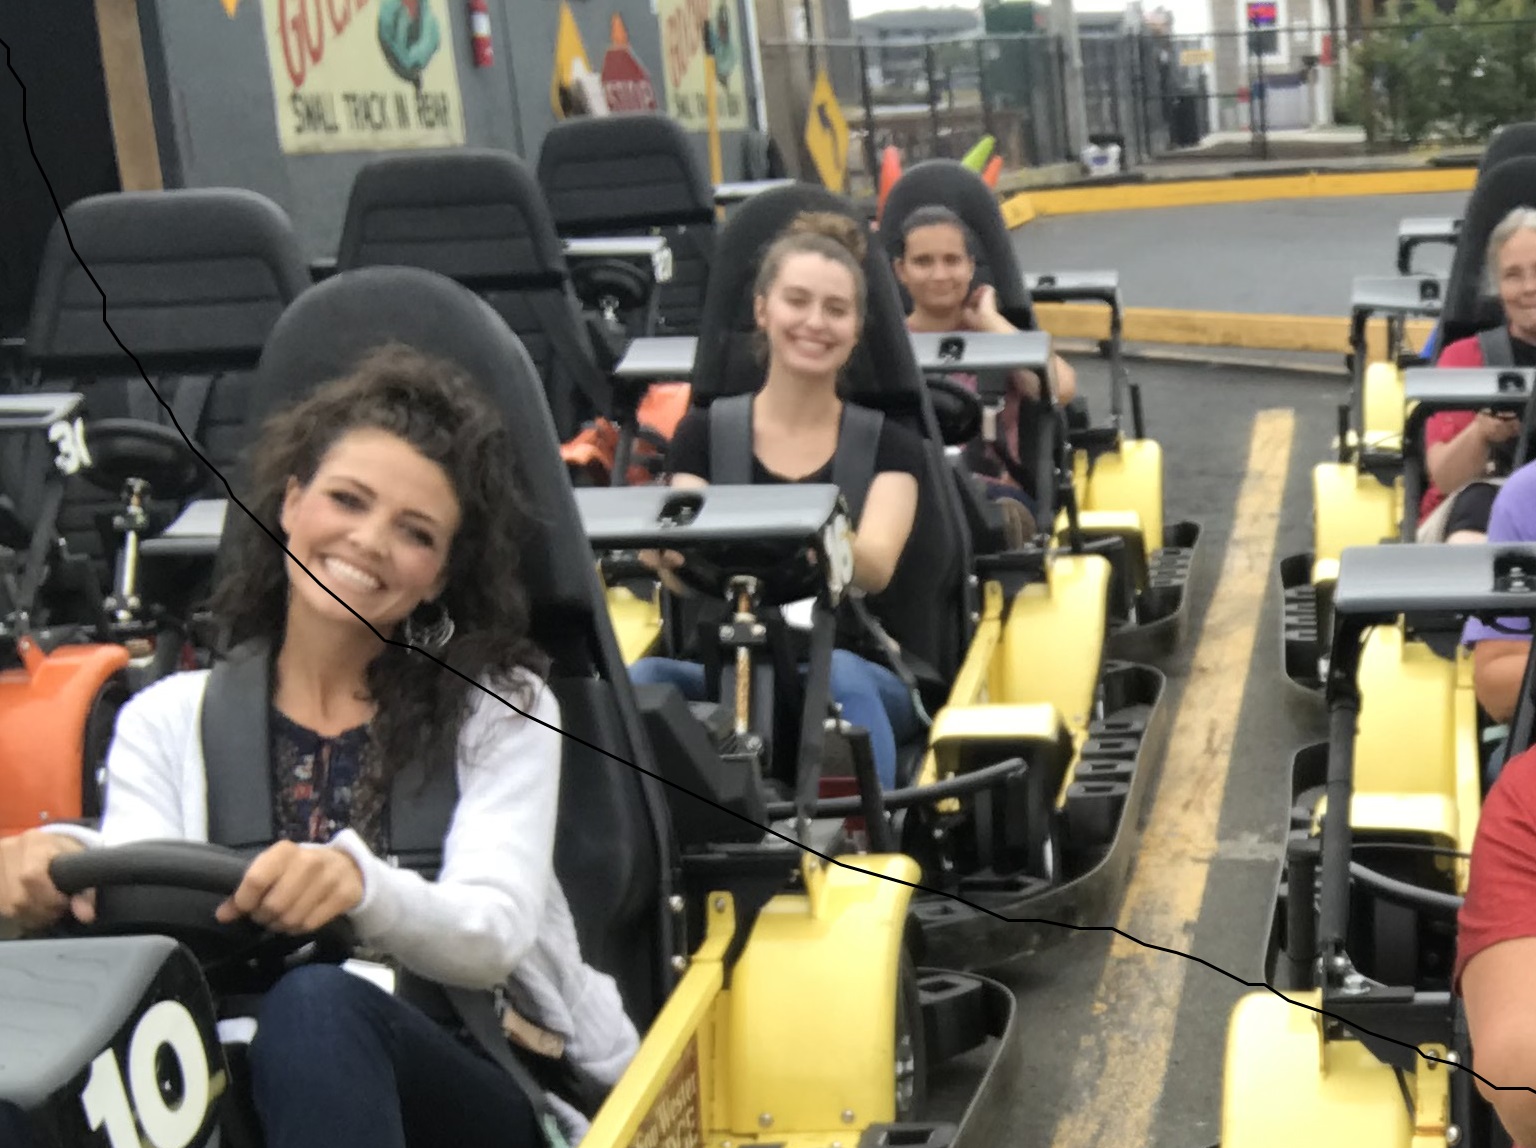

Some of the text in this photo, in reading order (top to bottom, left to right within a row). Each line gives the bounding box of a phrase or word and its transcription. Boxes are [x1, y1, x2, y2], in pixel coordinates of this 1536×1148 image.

[291, 92, 338, 133] SMALL
[342, 92, 388, 130] TRACK
[395, 92, 411, 129] IN
[603, 79, 657, 113] STOP
